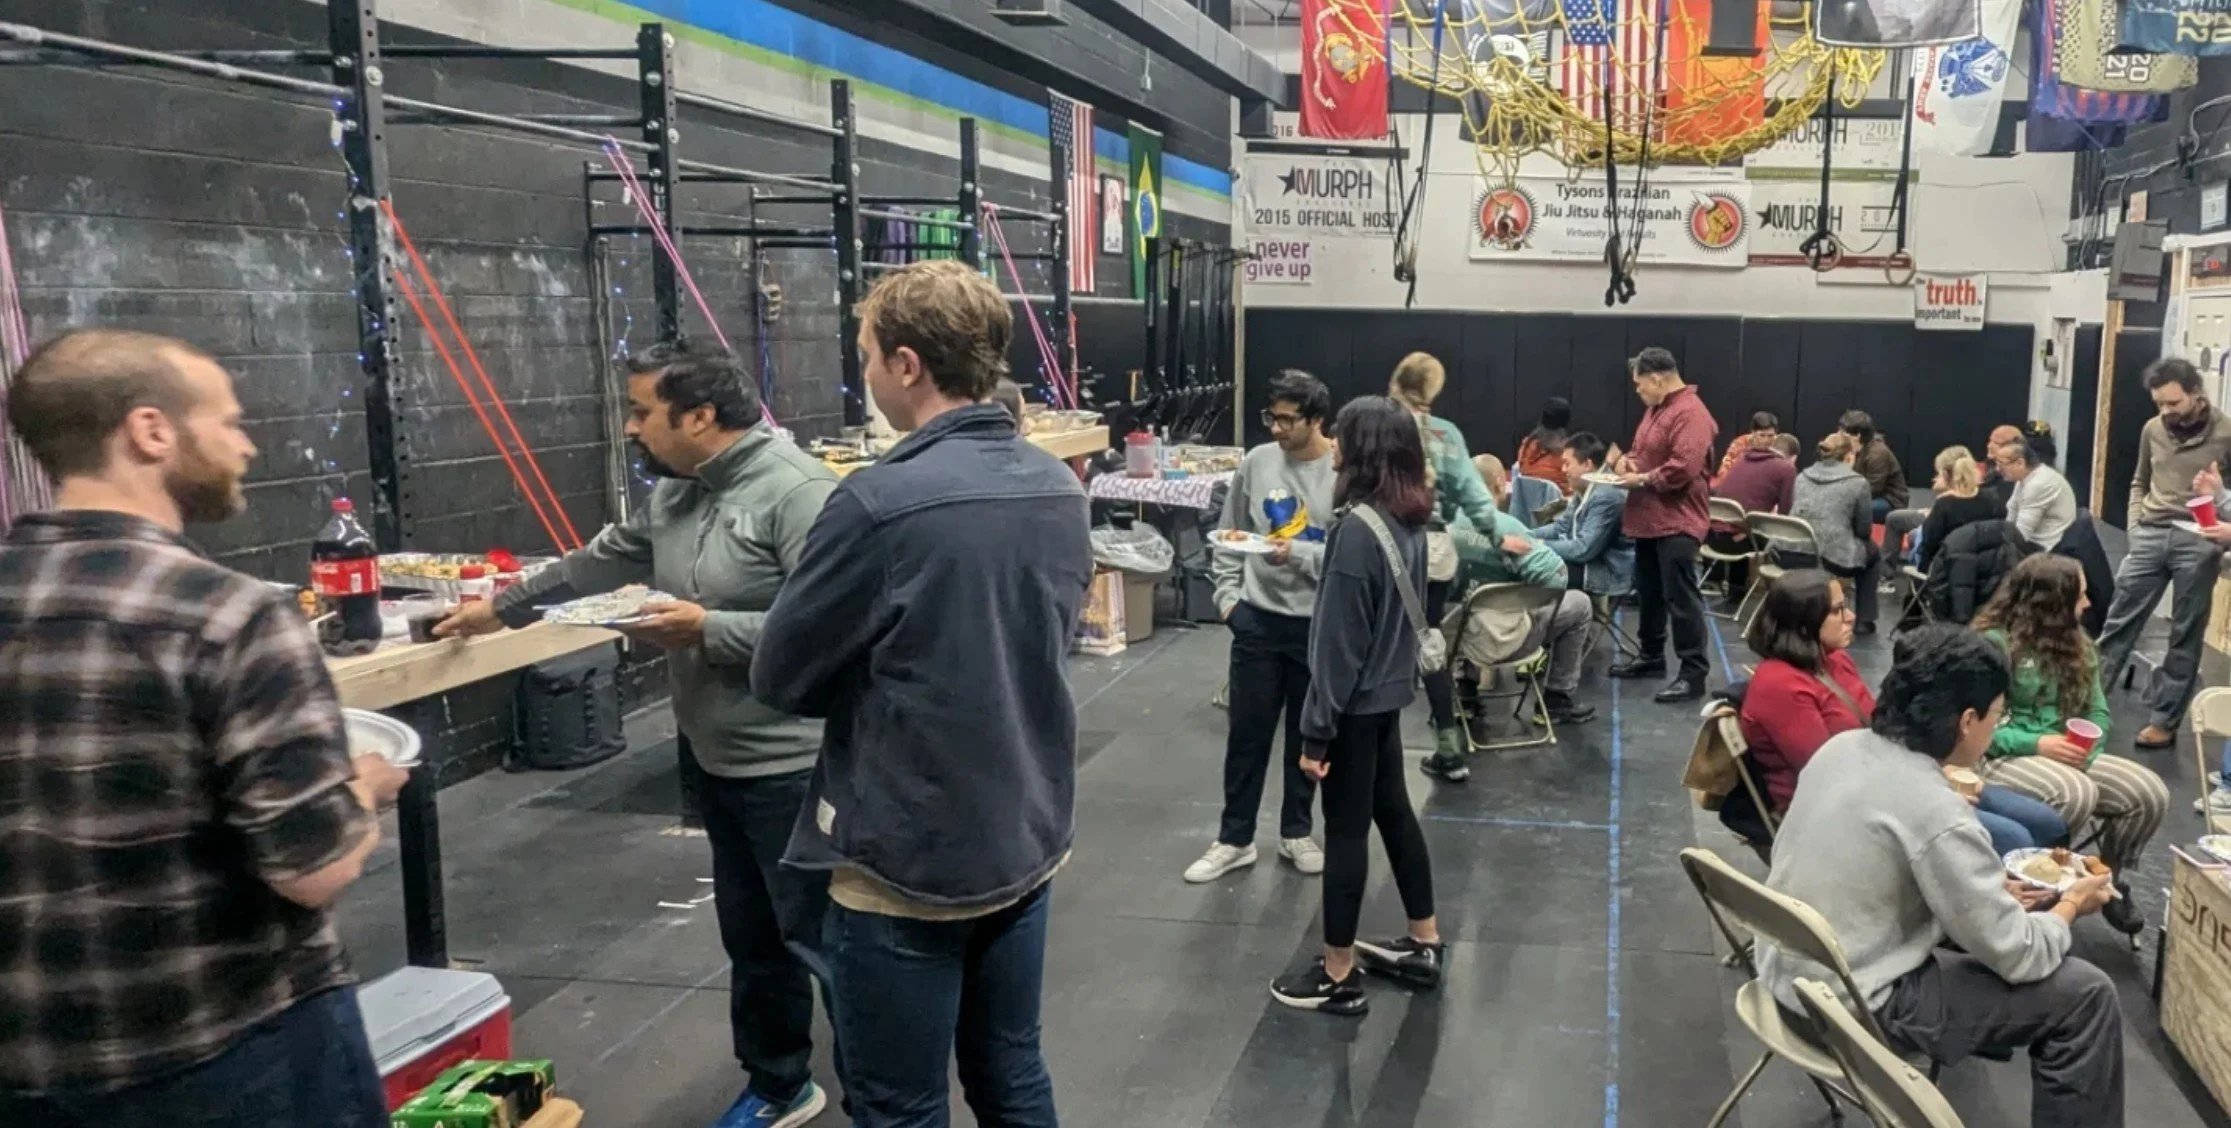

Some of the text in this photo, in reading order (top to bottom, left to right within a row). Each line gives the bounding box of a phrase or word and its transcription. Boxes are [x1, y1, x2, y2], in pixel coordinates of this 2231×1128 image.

[2105, 54, 2128, 79] 21
[2130, 53, 2152, 82] 20
[1296, 168, 1373, 199] MURPH
[1556, 183, 1604, 200] Tysons
[1255, 208, 1398, 229] 2015 OFFICIAL HOST
[1541, 203, 1563, 218] Jiu
[1565, 203, 1599, 218] Jitsu
[1772, 204, 1843, 231] MURH
[1256, 241, 1310, 259] never
[1247, 262, 1311, 281] give up
[1927, 278, 1976, 305] truth
